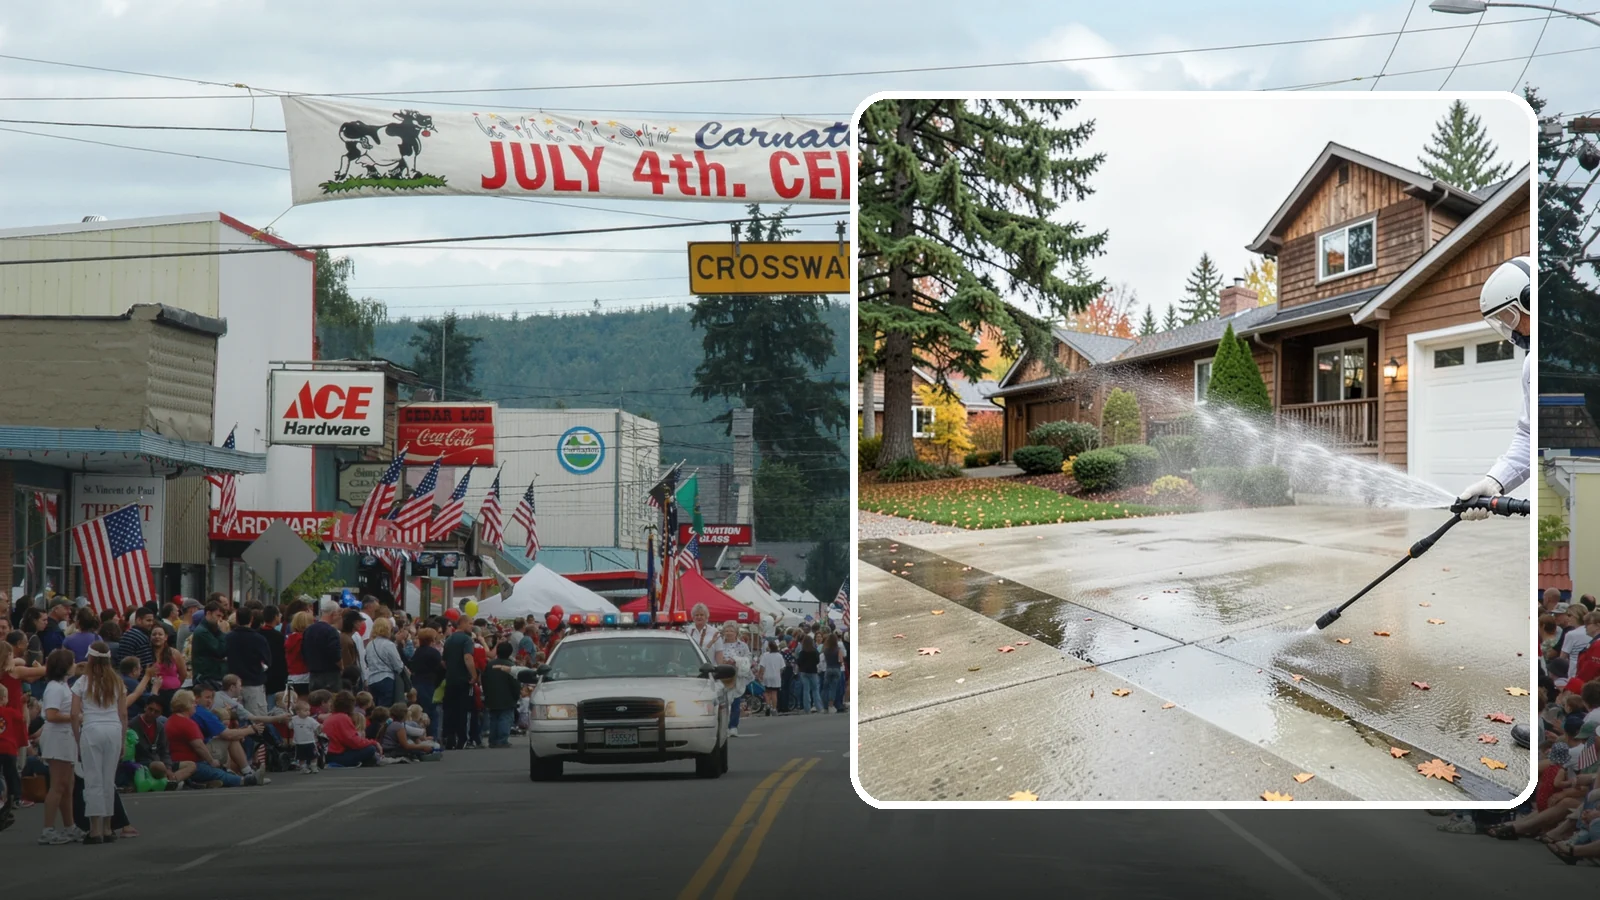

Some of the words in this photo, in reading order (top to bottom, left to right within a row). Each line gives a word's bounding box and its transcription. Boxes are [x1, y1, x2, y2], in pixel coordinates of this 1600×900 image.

[695, 121, 850, 149] Carnat
[481, 140, 605, 192] JULY
[632, 150, 746, 198] 4th.
[697, 254, 850, 280] CROSSWA
[282, 380, 373, 420] ACE
[406, 409, 452, 422] CEDAR
[461, 410, 485, 422] LOG
[283, 421, 371, 436] Hardware
[416, 428, 477, 447] Coca-Cola
[354, 467, 385, 479] Simpl
[96, 485, 124, 495] Vincent
[126, 486, 136, 495] de
[138, 486, 155, 496] Paul
[213, 515, 330, 535] HARDARE
[688, 526, 741, 535] CRNATION
[699, 535, 730, 543] GLASS
